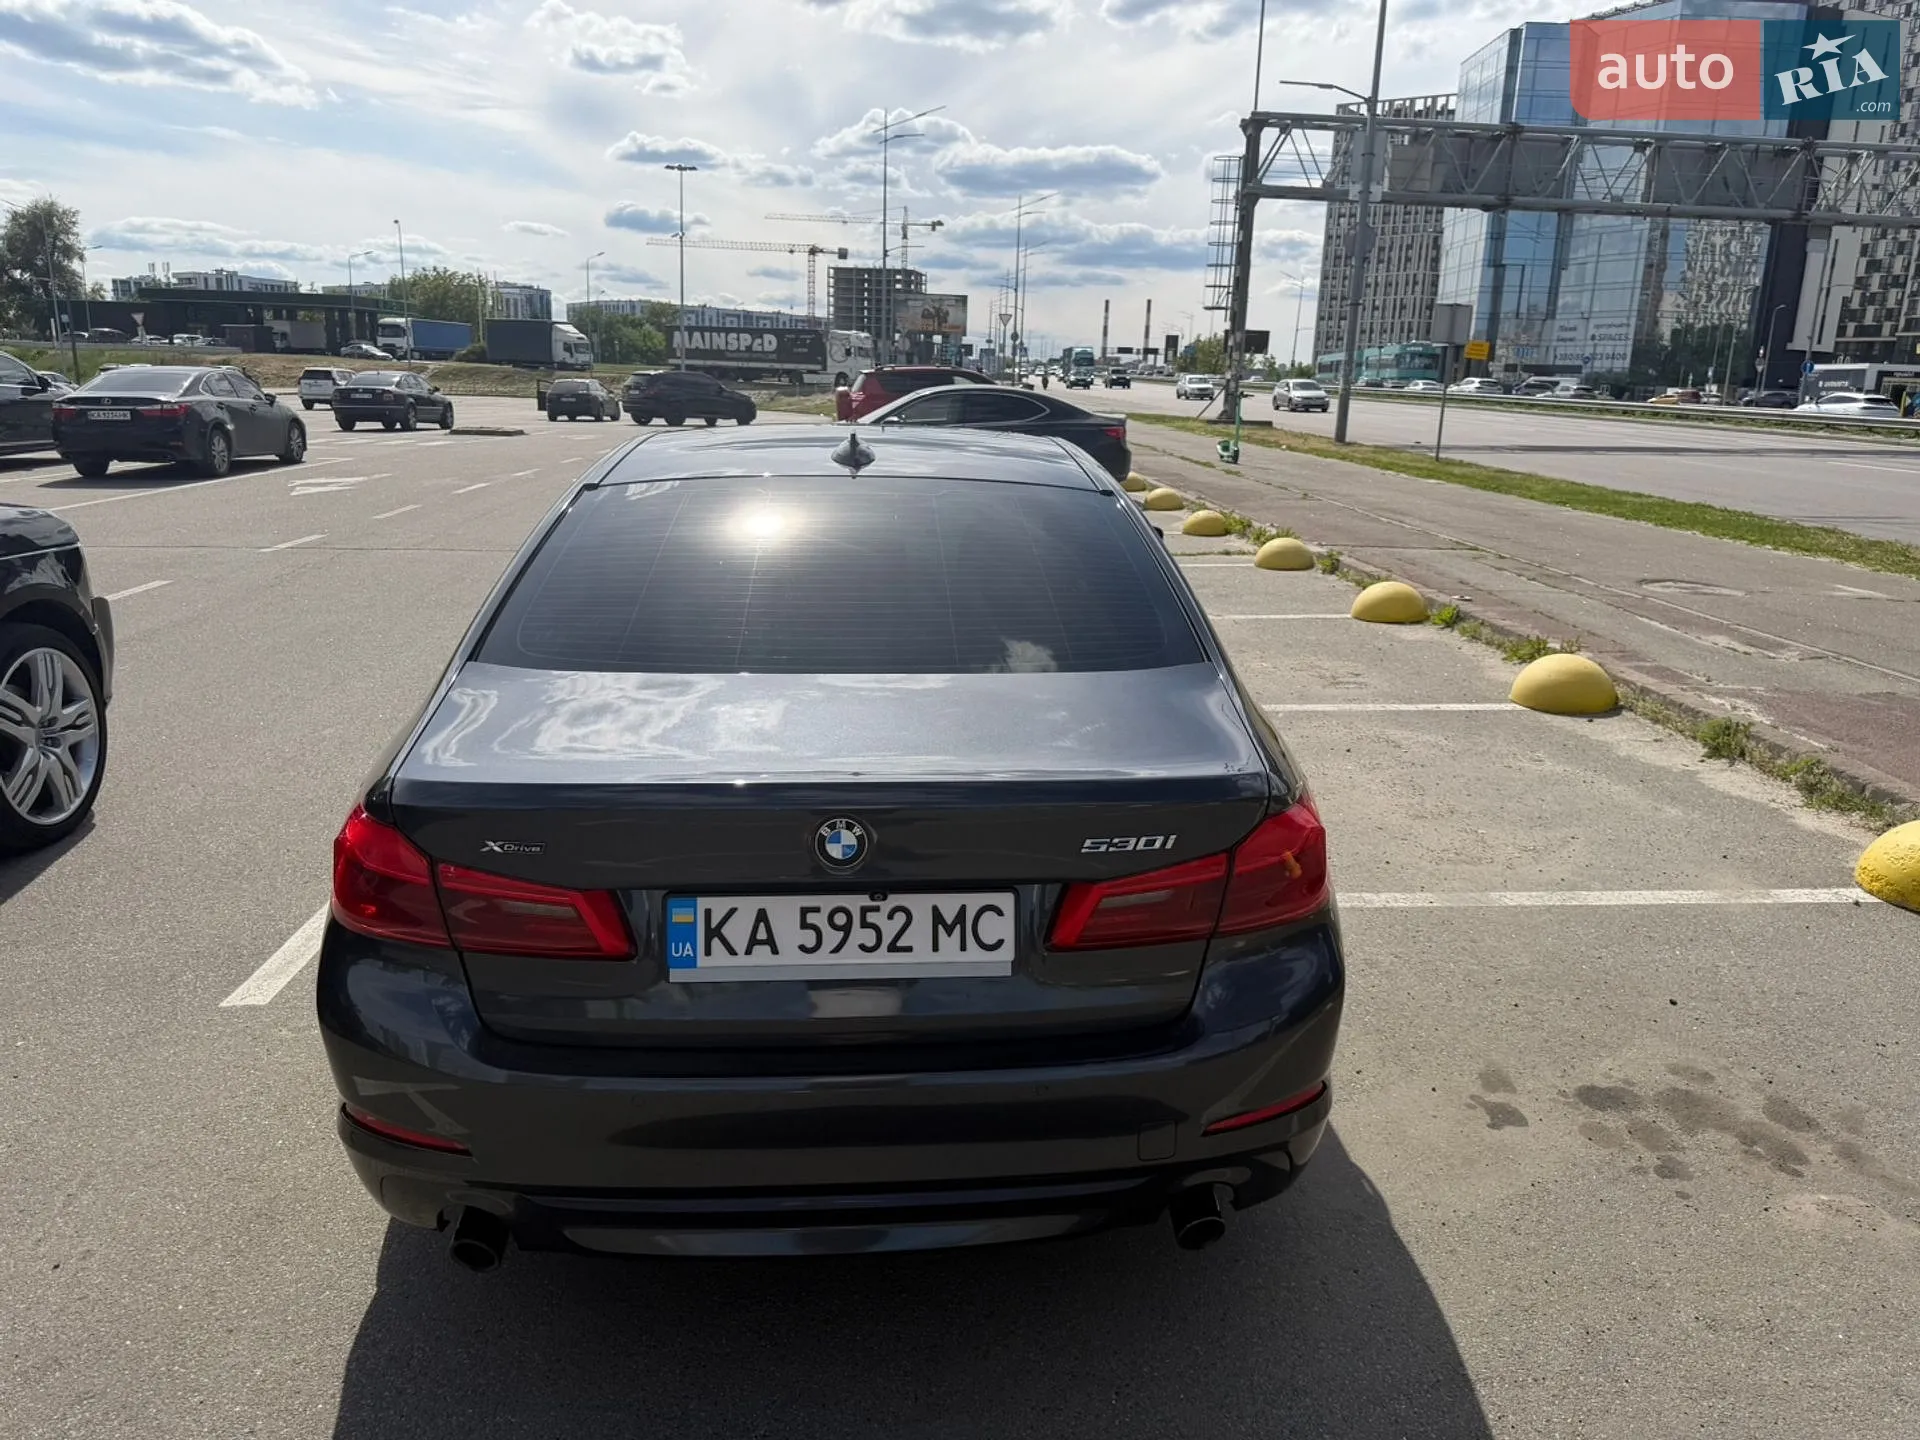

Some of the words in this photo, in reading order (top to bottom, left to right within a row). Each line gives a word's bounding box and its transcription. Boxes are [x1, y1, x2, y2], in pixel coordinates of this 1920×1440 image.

[820, 819, 864, 837] BMW
[704, 906, 779, 957] KA
[797, 905, 913, 955] 5952
[931, 903, 1005, 953] MC
[672, 942, 694, 958] UA
